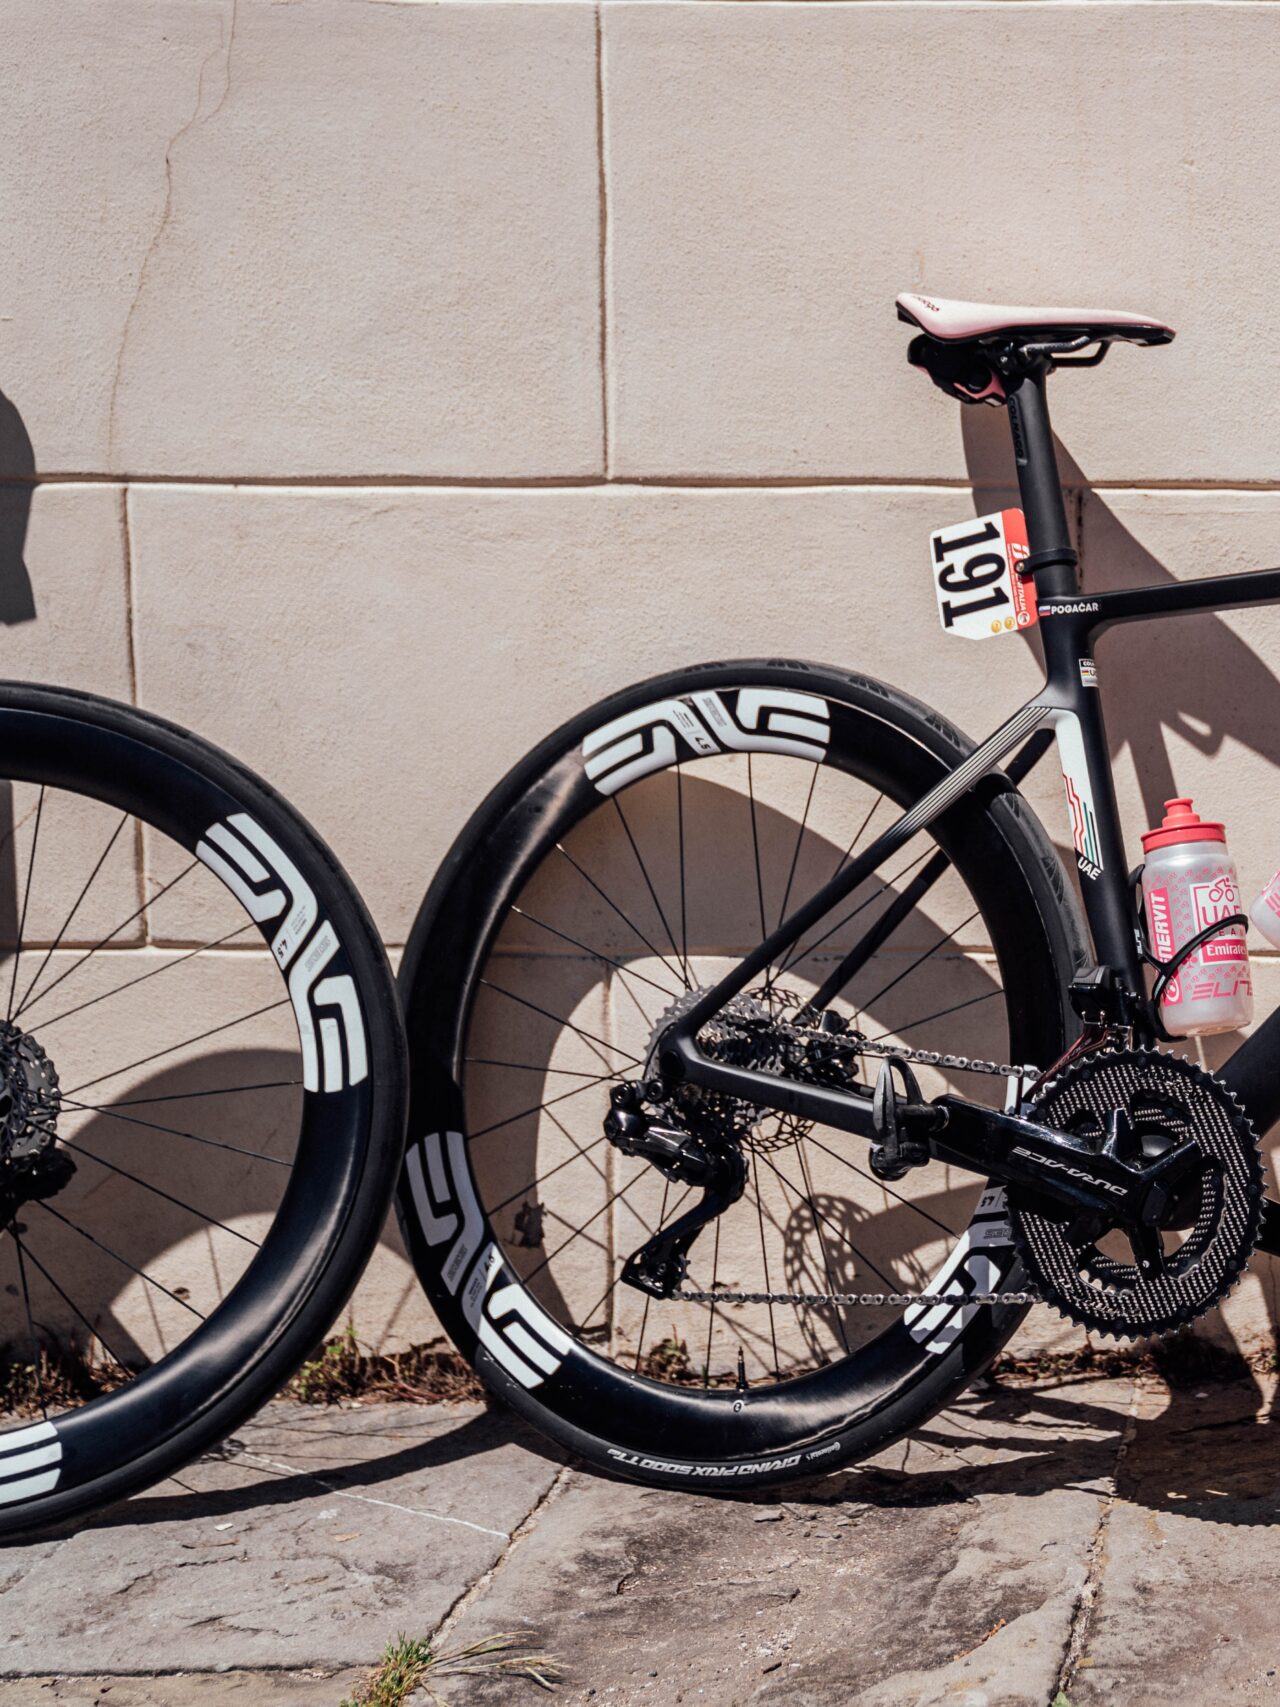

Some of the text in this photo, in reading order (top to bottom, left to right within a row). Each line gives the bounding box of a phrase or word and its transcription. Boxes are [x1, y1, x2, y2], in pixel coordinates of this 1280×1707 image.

[932, 521, 1010, 629] 191
[1051, 602, 1099, 615] POGAČAR
[1077, 855, 1102, 881] UAE
[1206, 943, 1248, 957] Emirates
[1191, 979, 1253, 1000] ELIT
[1012, 1146, 1129, 1197] DURA-ACE
[639, 1459, 693, 1475] 5000
[691, 1464, 738, 1477] PRIX
[737, 1454, 802, 1475] GRAND
